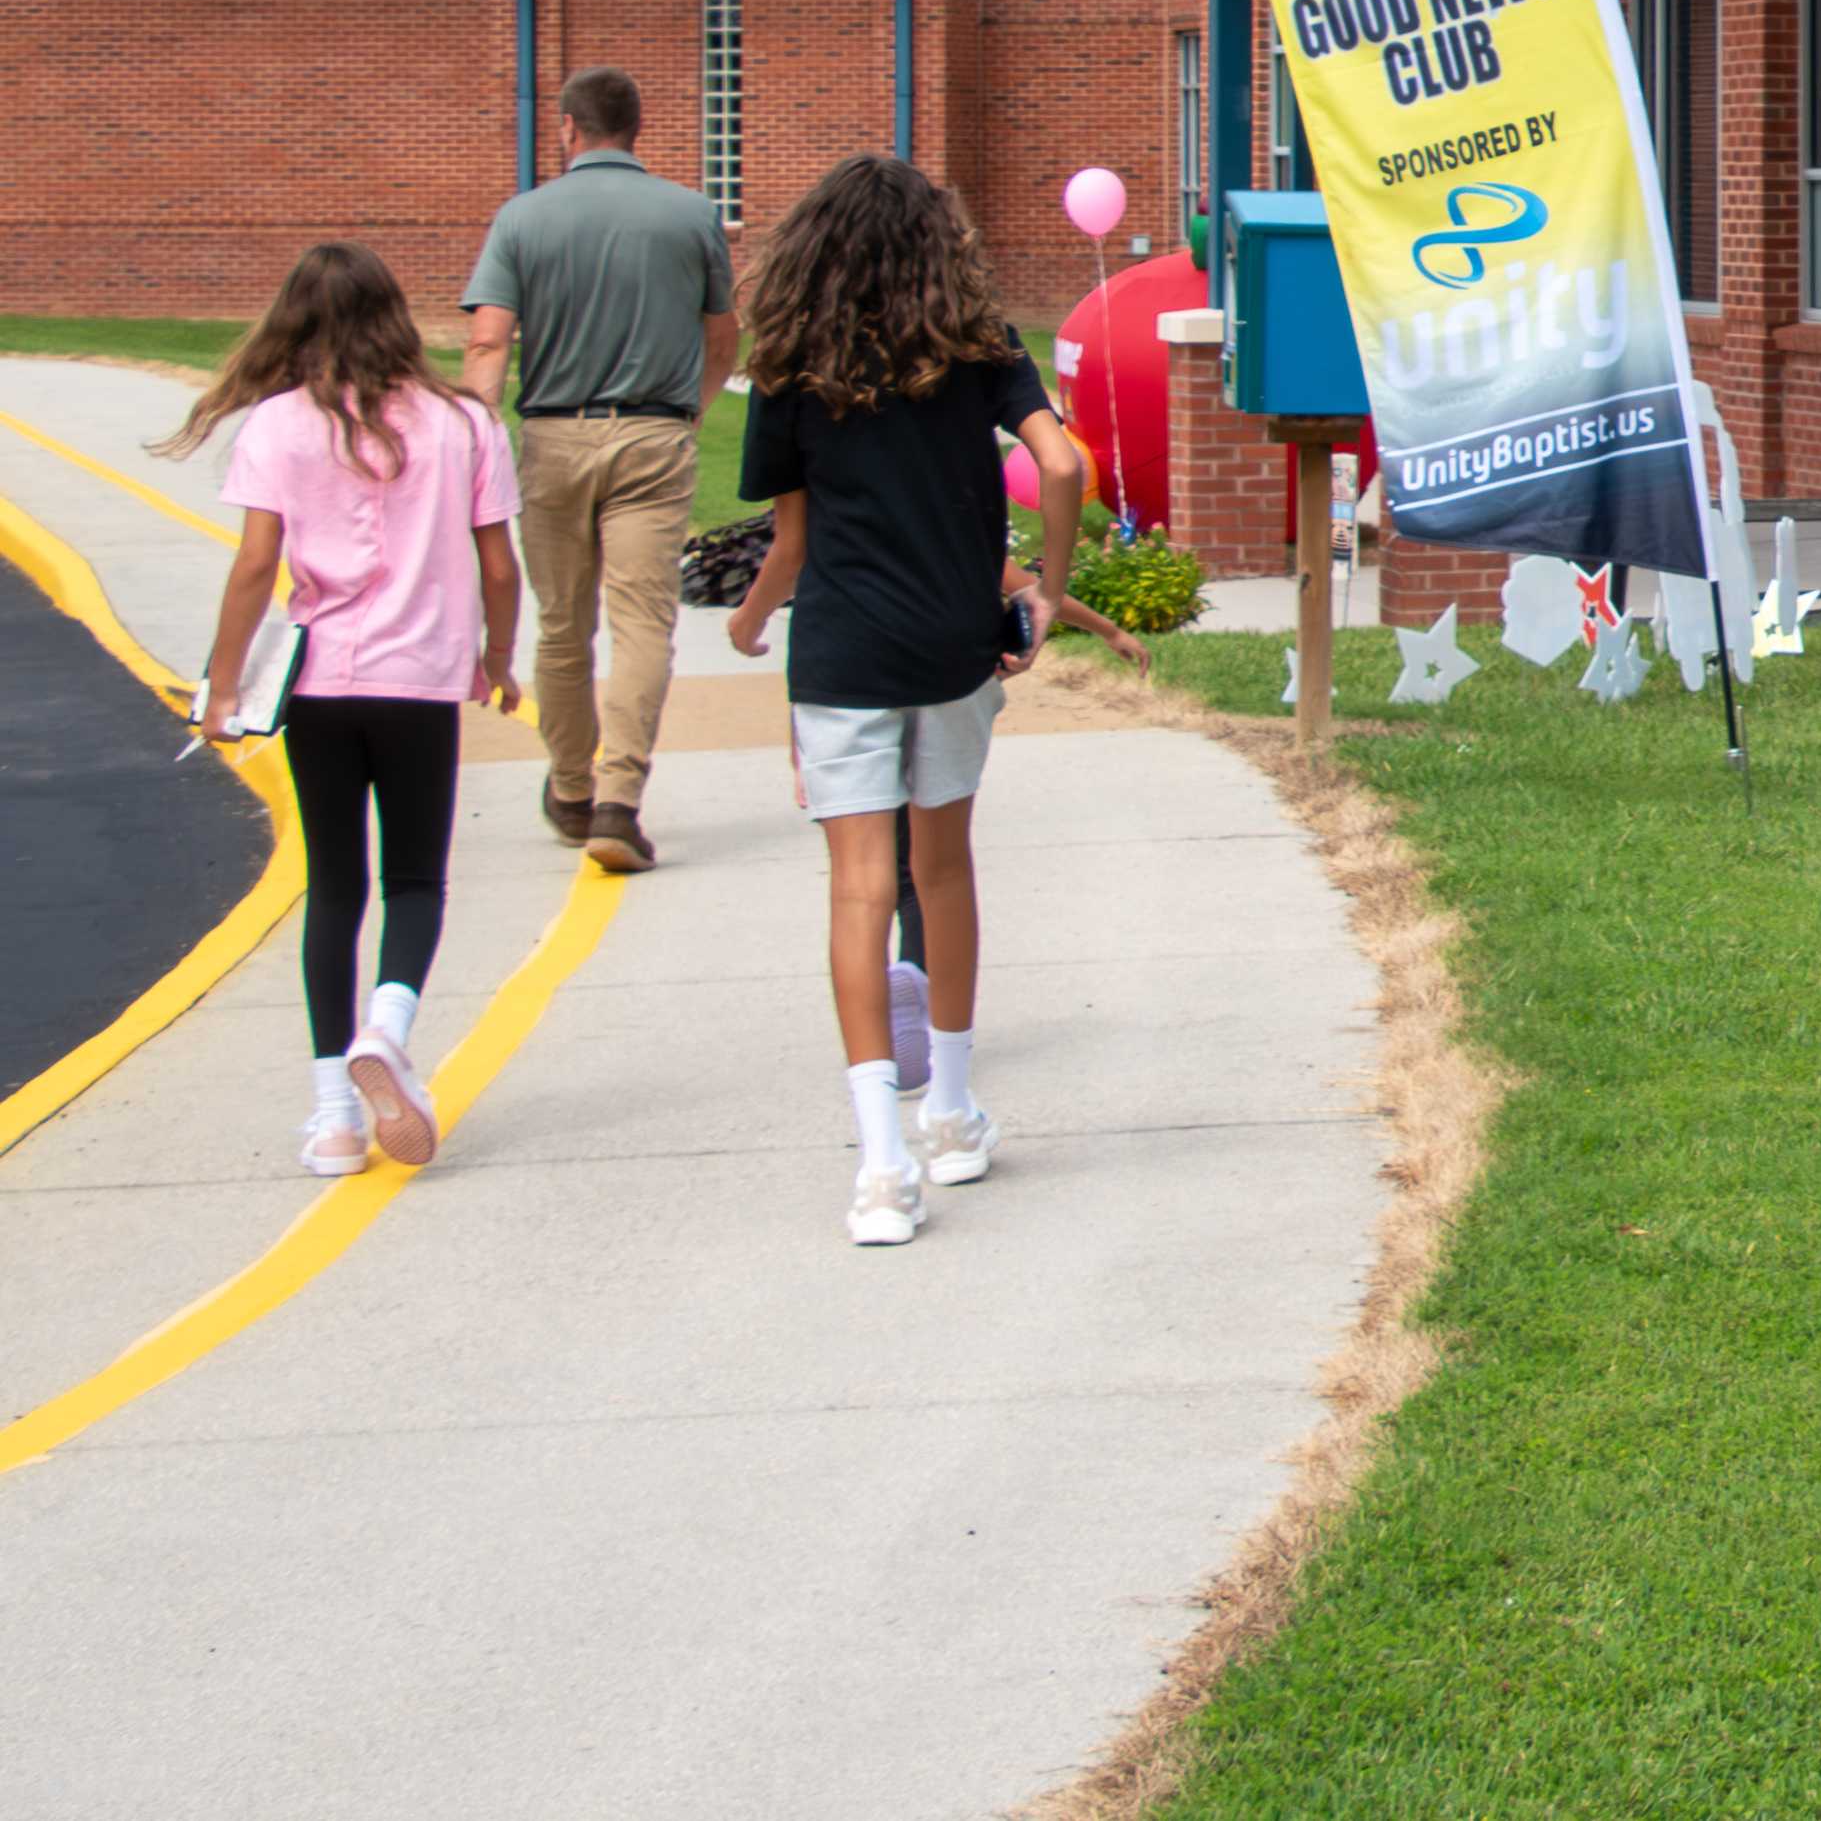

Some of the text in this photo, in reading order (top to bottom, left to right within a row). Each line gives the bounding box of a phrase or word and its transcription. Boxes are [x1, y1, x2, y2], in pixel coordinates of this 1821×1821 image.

[1382, 18, 1501, 106] CLUB
[1378, 110, 1557, 187] SPONSORED BY
[1379, 258, 1628, 390] unity
[1402, 406, 1656, 492] UnityBaptist.us
